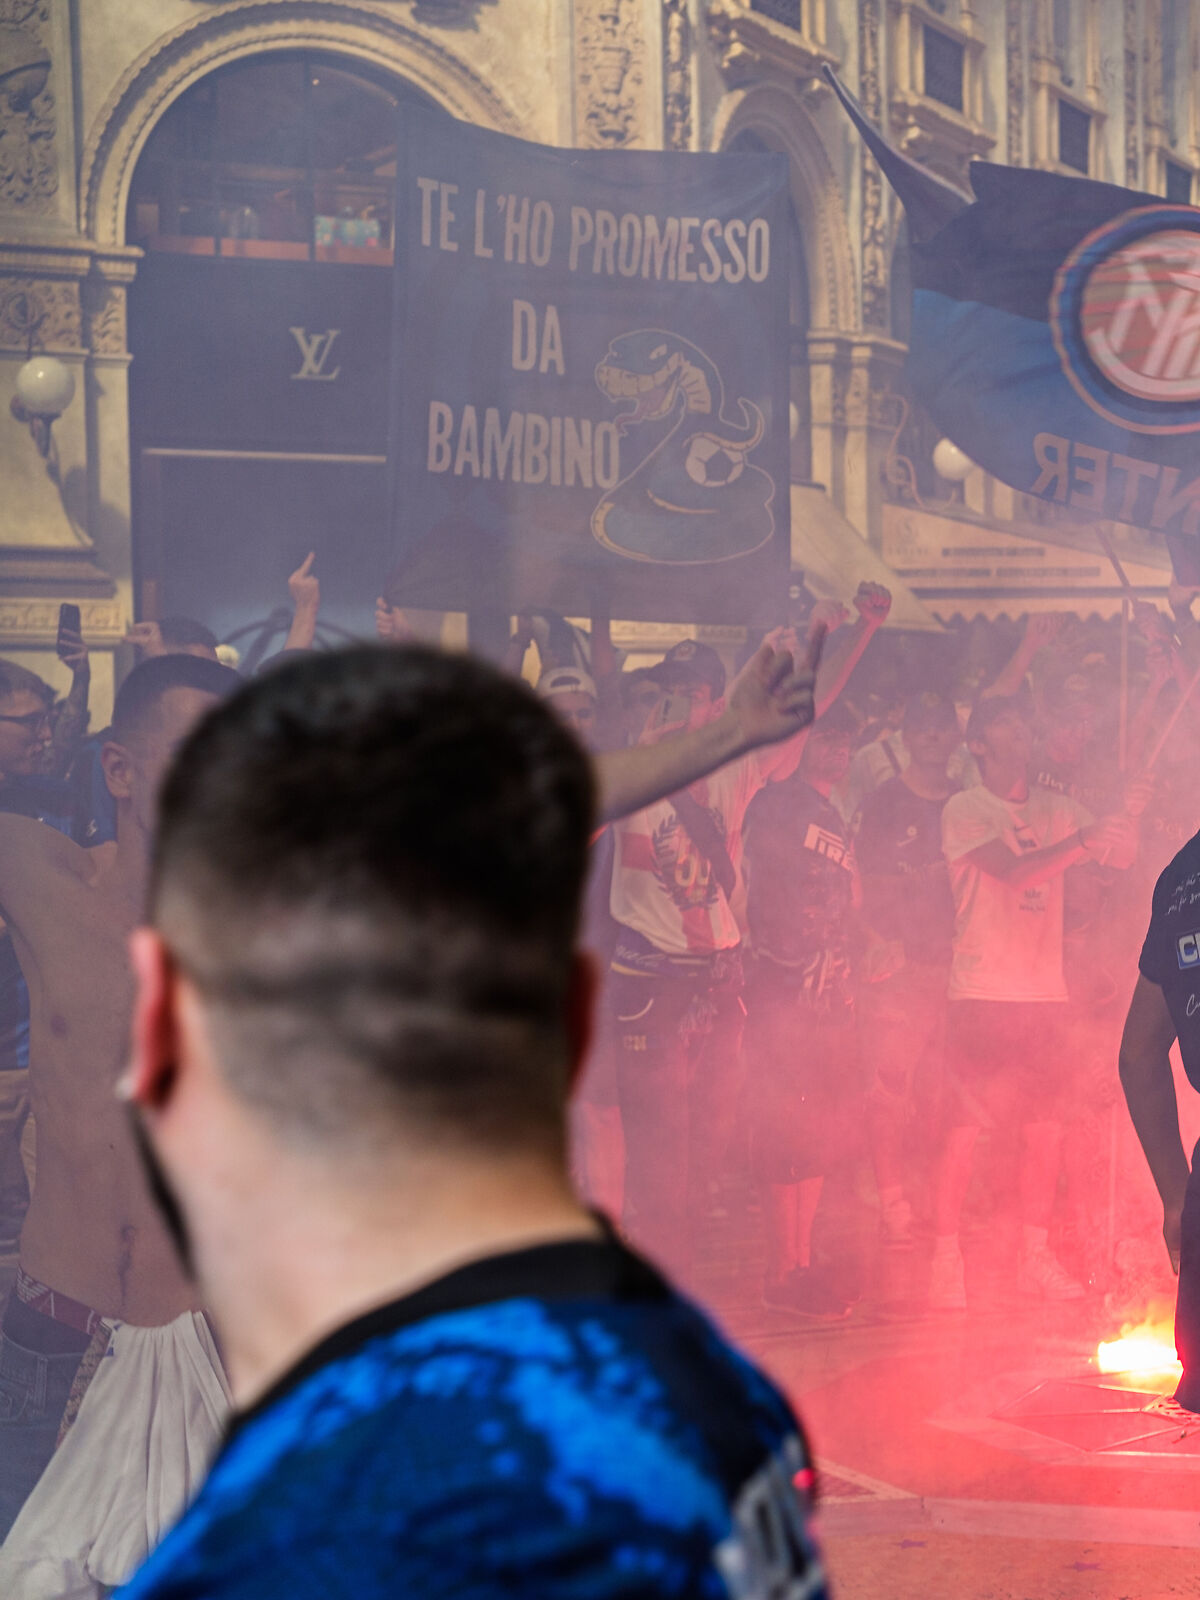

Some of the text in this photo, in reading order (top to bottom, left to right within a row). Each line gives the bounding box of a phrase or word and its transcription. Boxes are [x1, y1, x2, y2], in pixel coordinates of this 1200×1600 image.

[418, 177, 770, 283] TE L'HO PROMESSO
[511, 299, 565, 376] DA
[427, 401, 620, 489] BAMBINO
